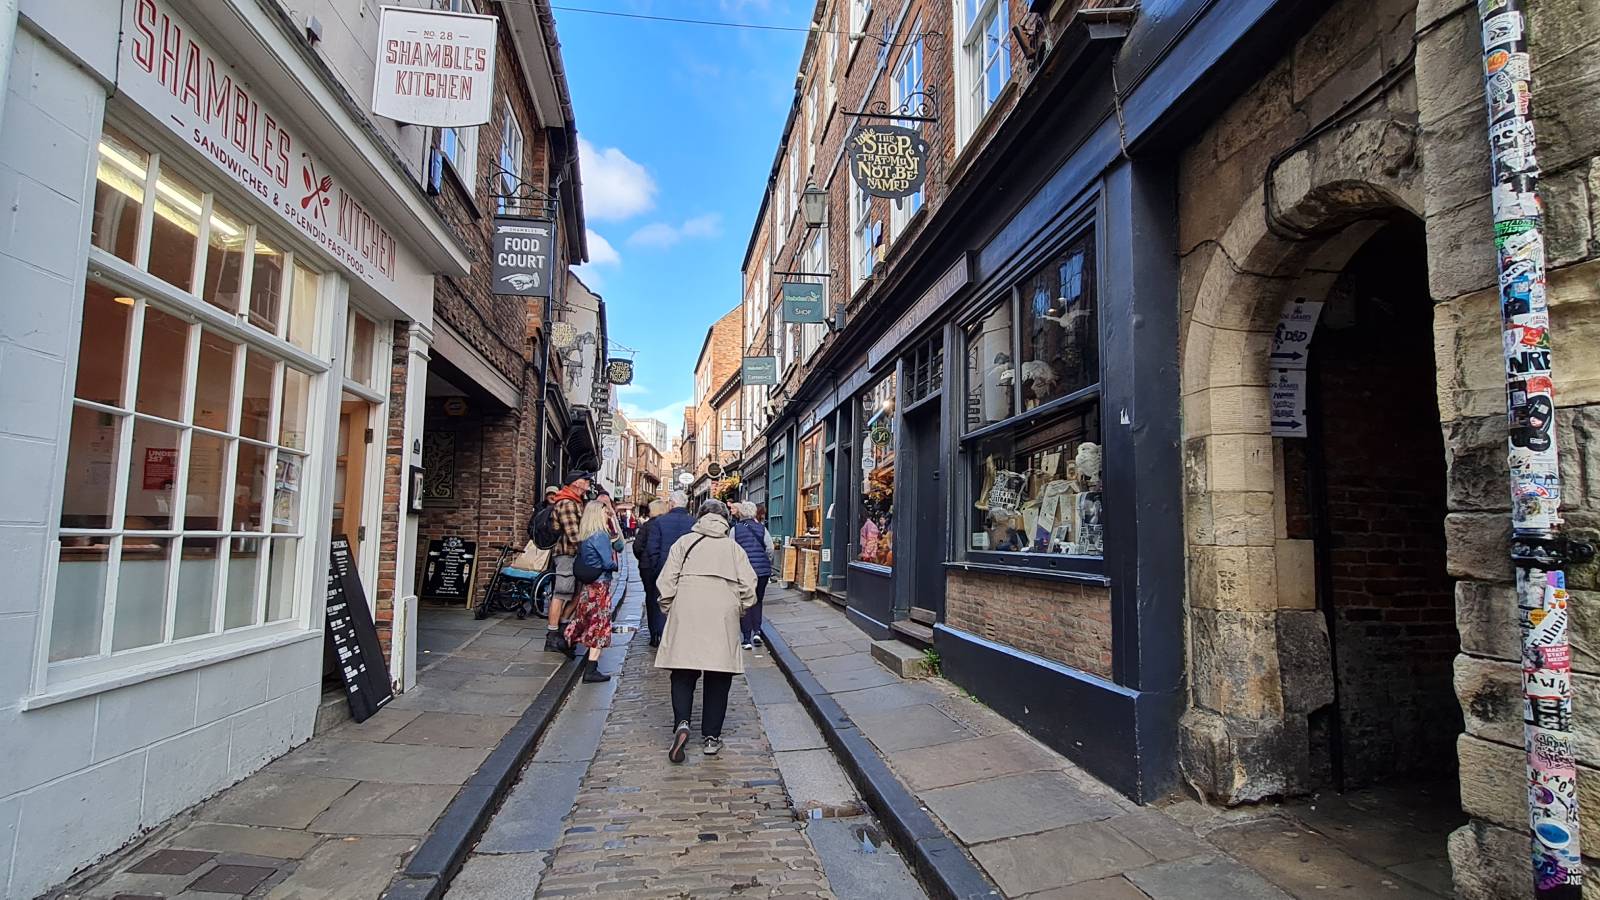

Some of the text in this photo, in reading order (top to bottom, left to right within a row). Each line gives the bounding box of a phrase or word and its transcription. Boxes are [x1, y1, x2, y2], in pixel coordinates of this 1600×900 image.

[440, 32, 453, 40] 28
[386, 40, 486, 72] SHAMBLES
[395, 70, 473, 100] KITCHEN
[131, 0, 396, 282] SHAMBLES KITCHEN
[862, 134, 911, 156] SHOP
[876, 132, 897, 144] THE
[856, 145, 919, 174] THAT MUST
[858, 162, 917, 180] NOT BE
[193, 128, 268, 200] SANDWICHES
[273, 193, 279, 206] &
[284, 203, 326, 244] SPLENDID
[327, 238, 347, 259] FAST
[867, 178, 909, 192] NAMED
[504, 237, 540, 251] FOOD
[498, 252, 546, 269] COURT
[1285, 331, 1308, 342] D&D
